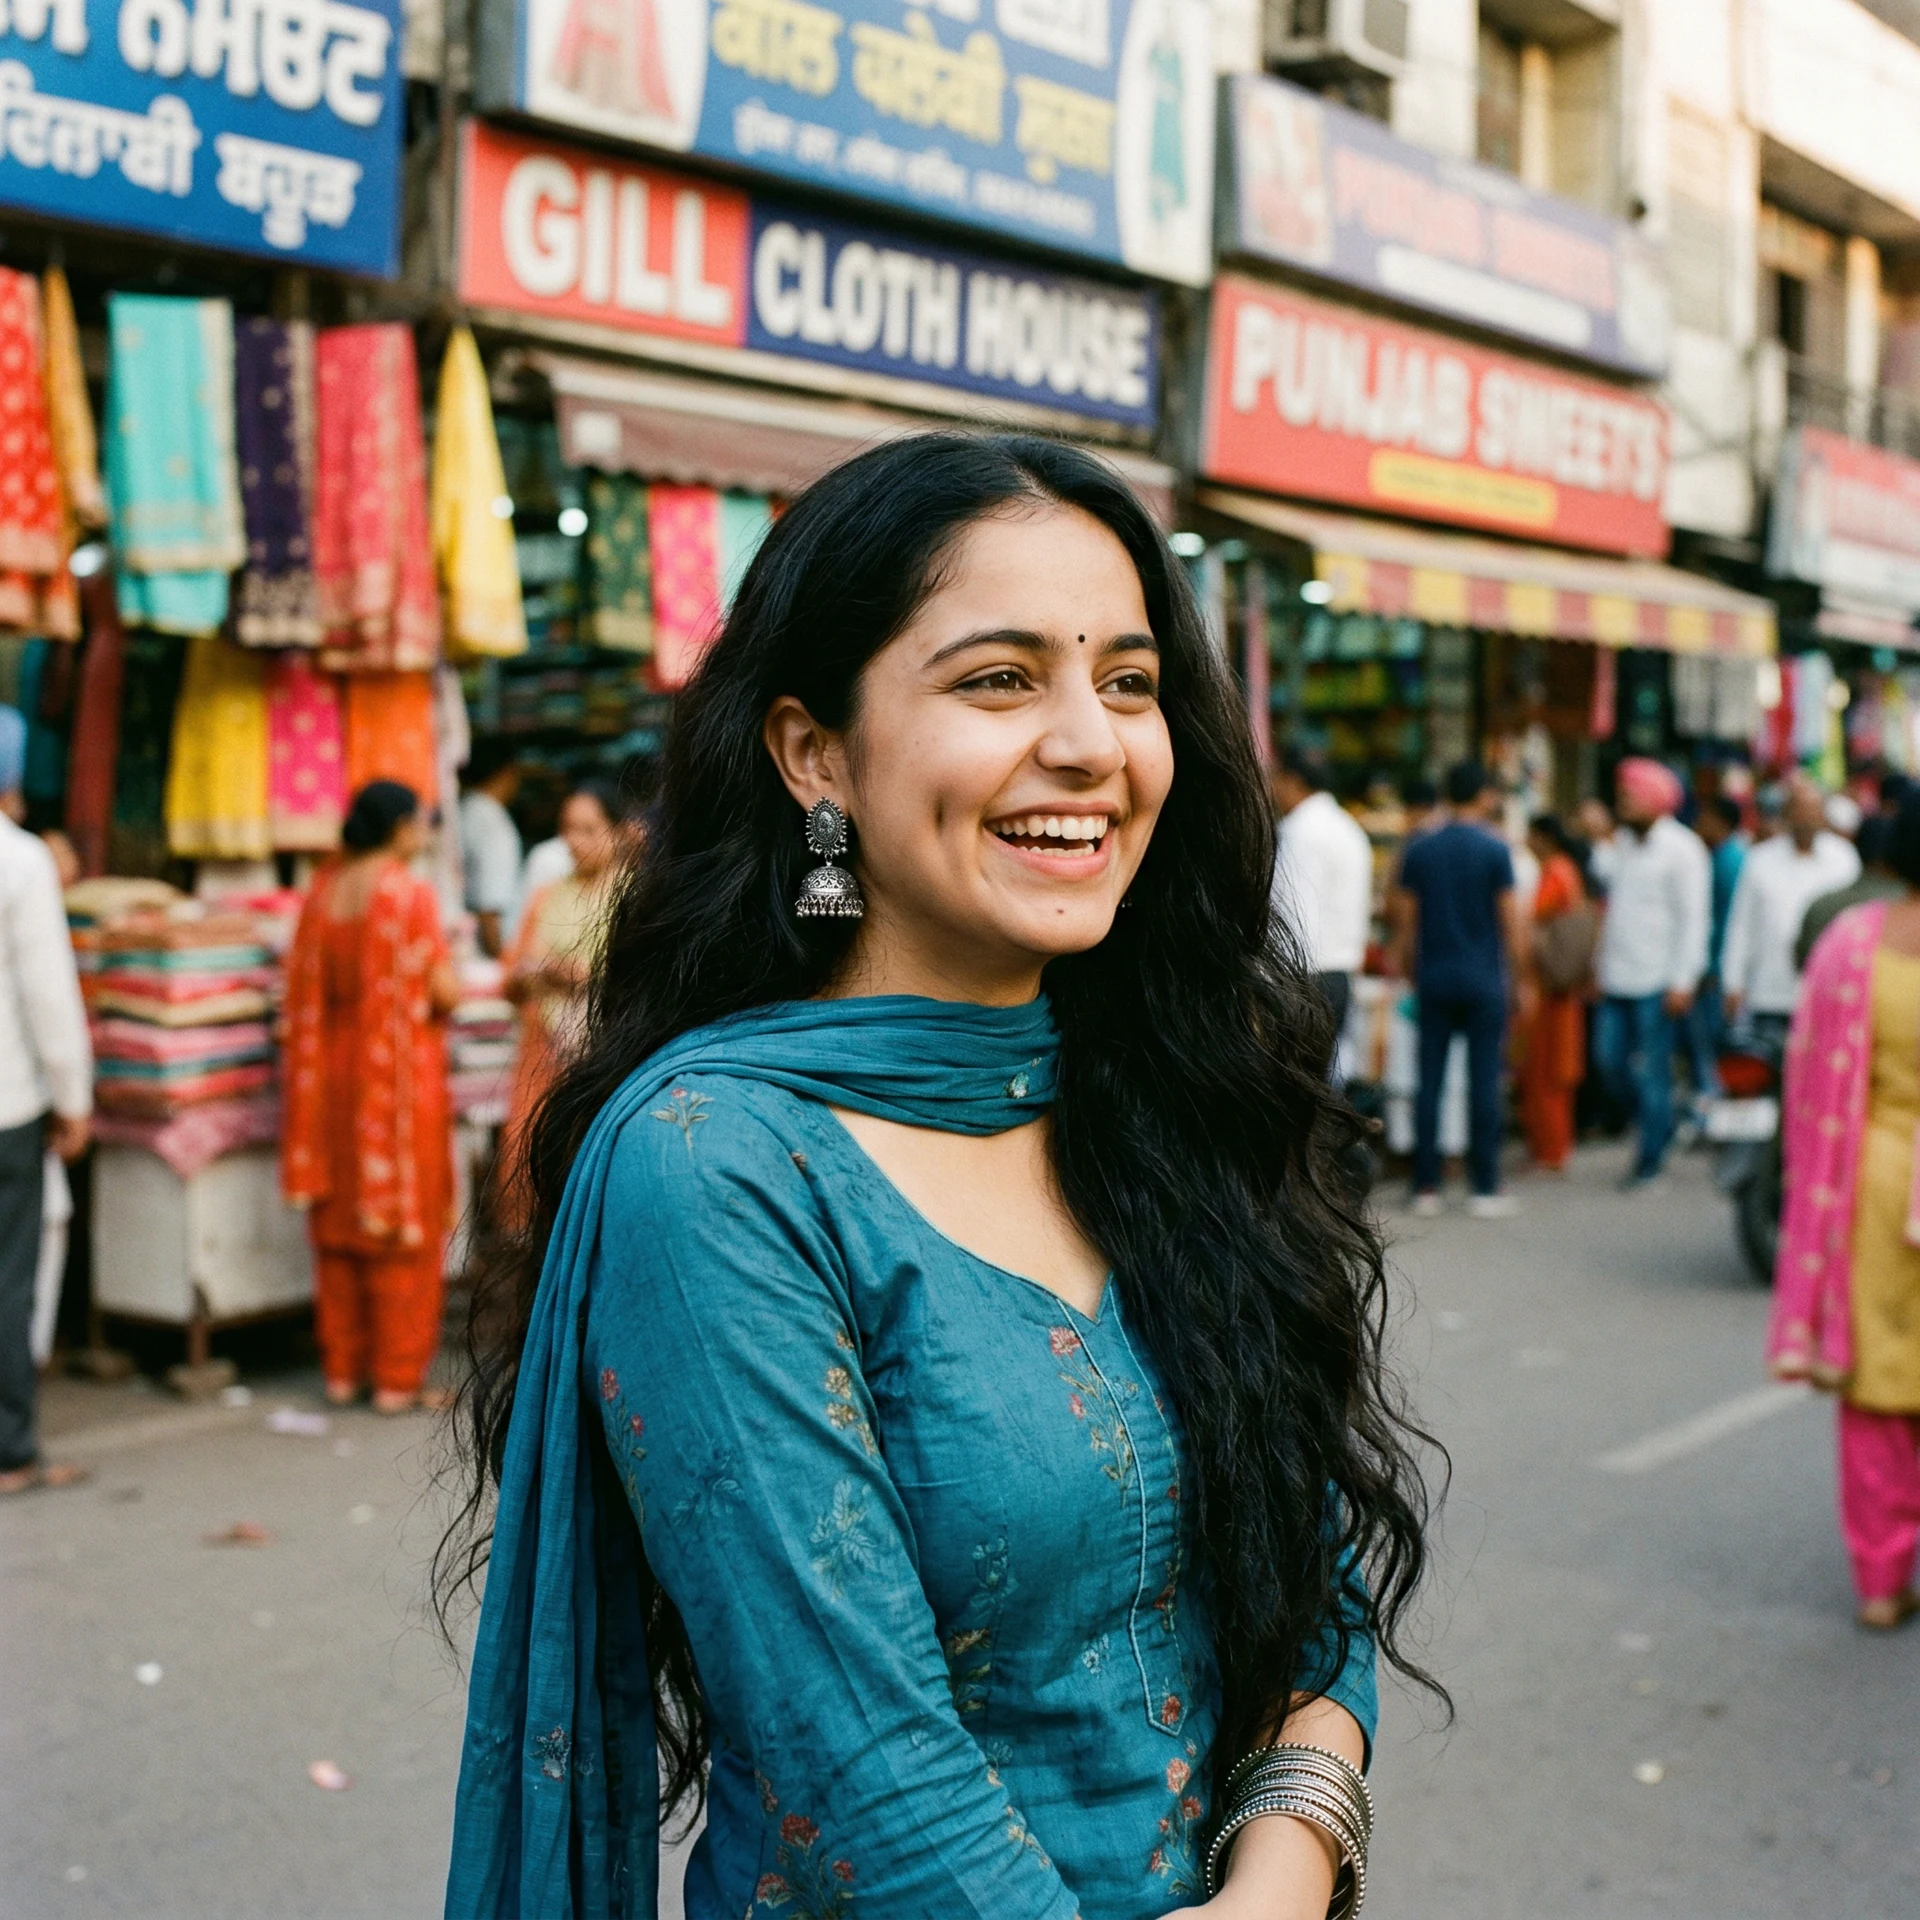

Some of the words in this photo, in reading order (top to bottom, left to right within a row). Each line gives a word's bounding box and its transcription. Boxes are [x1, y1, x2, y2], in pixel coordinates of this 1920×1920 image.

[503, 155, 733, 328] GILL
[753, 221, 959, 370] CLOTH
[965, 272, 1150, 408] HOUSE
[1231, 301, 1471, 460] PUNJAB
